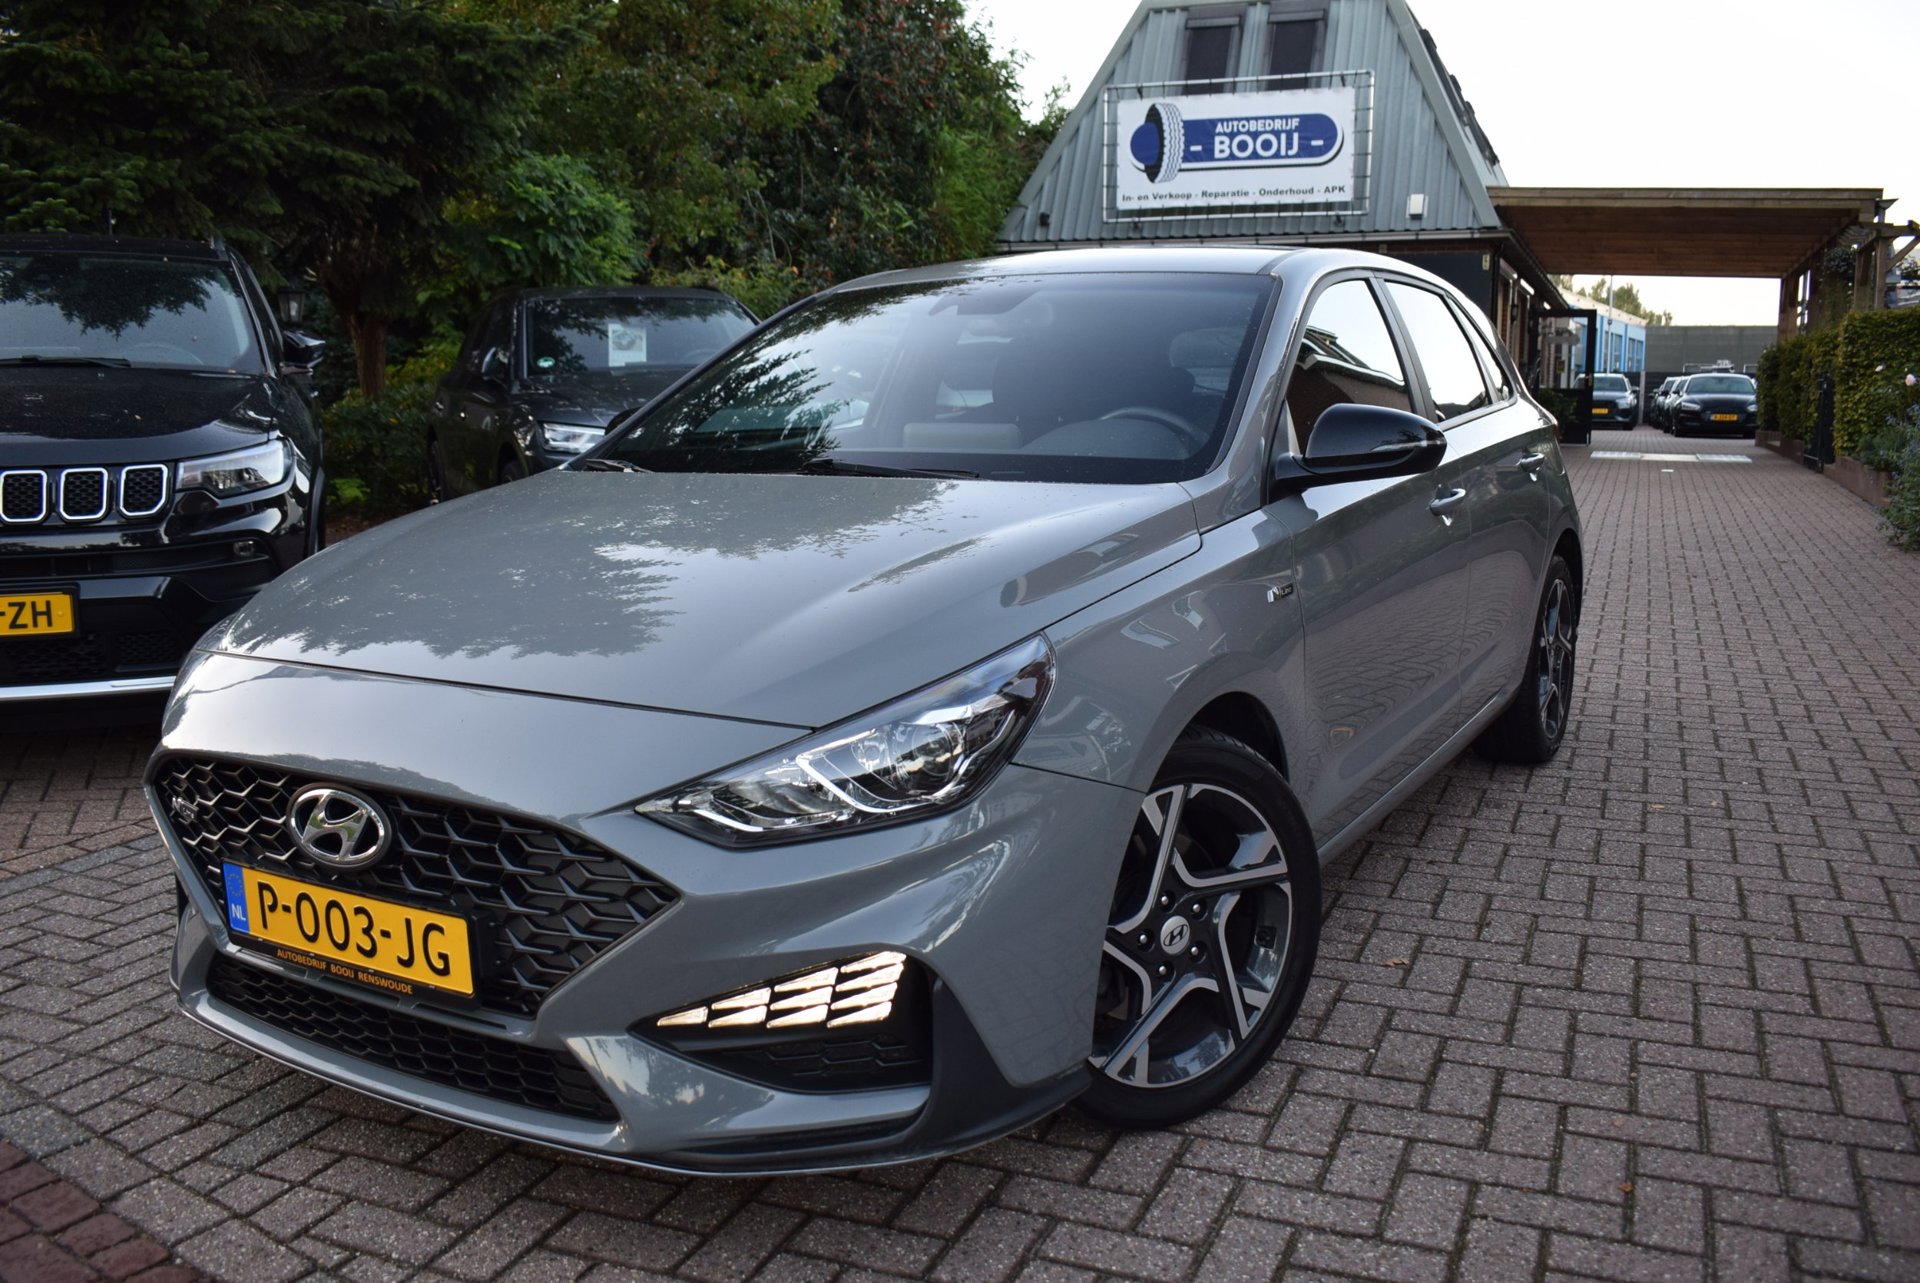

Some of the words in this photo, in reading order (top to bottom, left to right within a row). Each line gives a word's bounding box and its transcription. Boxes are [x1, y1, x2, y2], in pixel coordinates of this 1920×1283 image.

[1215, 118, 1300, 133] AUTOBEDRIJF
[1213, 132, 1299, 159] BOOIJ
[1152, 191, 1192, 201] Verkoop
[1201, 189, 1249, 199] Reparatie
[1259, 187, 1314, 197] Onderhoud
[1324, 185, 1346, 194] APK
[231, 903, 247, 922] NL
[256, 879, 451, 978] P-003-JG
[277, 949, 327, 970] AUTOBEDRIJF
[330, 964, 355, 979] BOOIJ
[358, 971, 413, 994] RENSWOUDE
